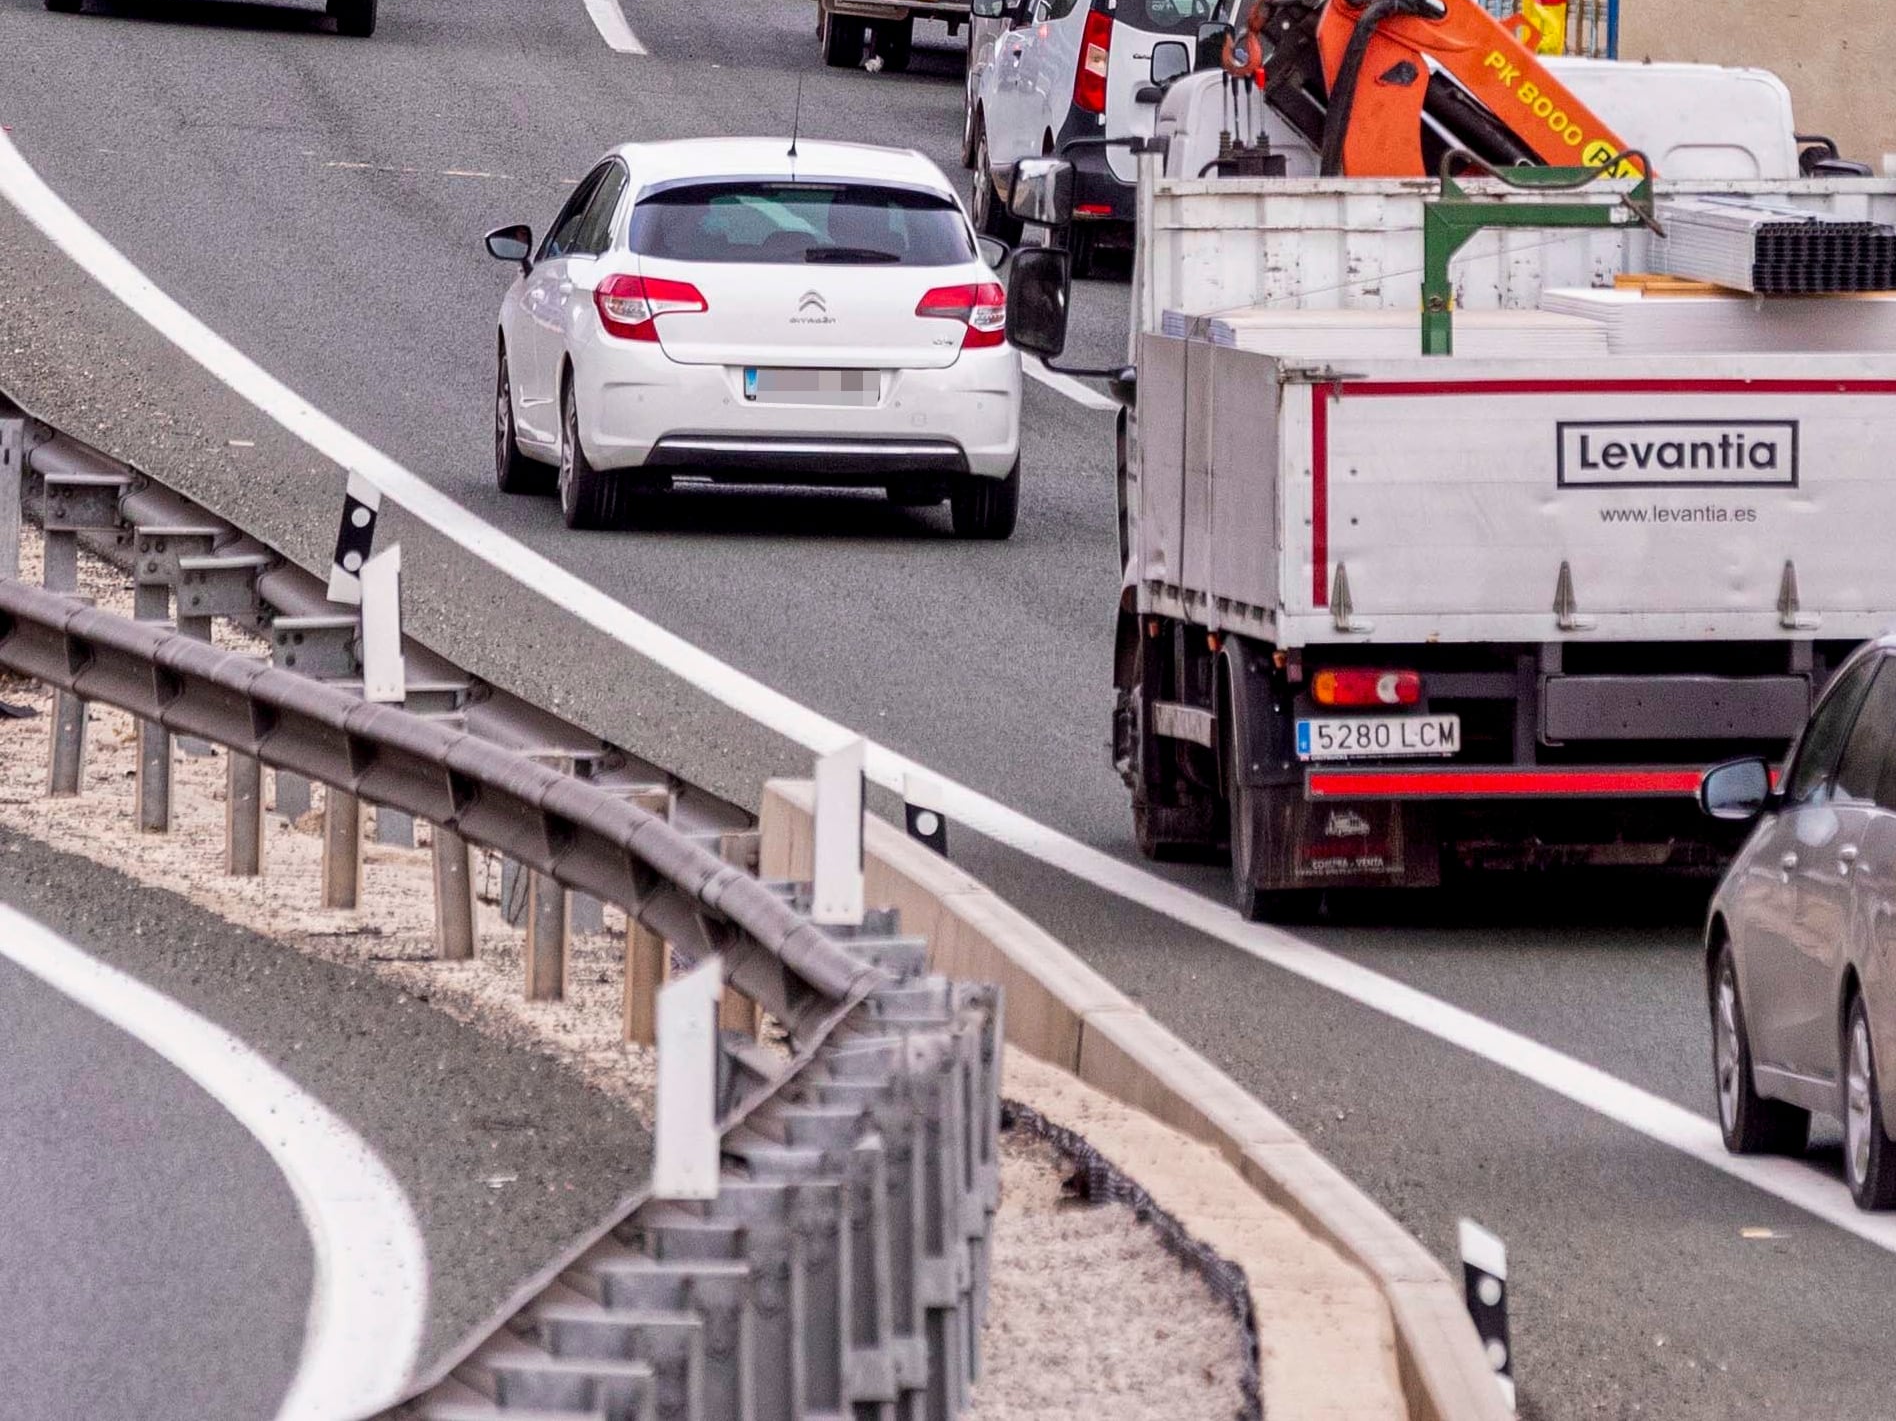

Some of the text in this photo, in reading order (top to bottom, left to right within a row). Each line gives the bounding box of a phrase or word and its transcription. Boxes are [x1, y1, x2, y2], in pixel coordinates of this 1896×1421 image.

[1484, 51, 1583, 147] PK 8000
[1580, 434, 1777, 470] Levantia
[1600, 504, 1757, 522] www.levantia.es
[1319, 721, 1454, 749] 5280 LCM
